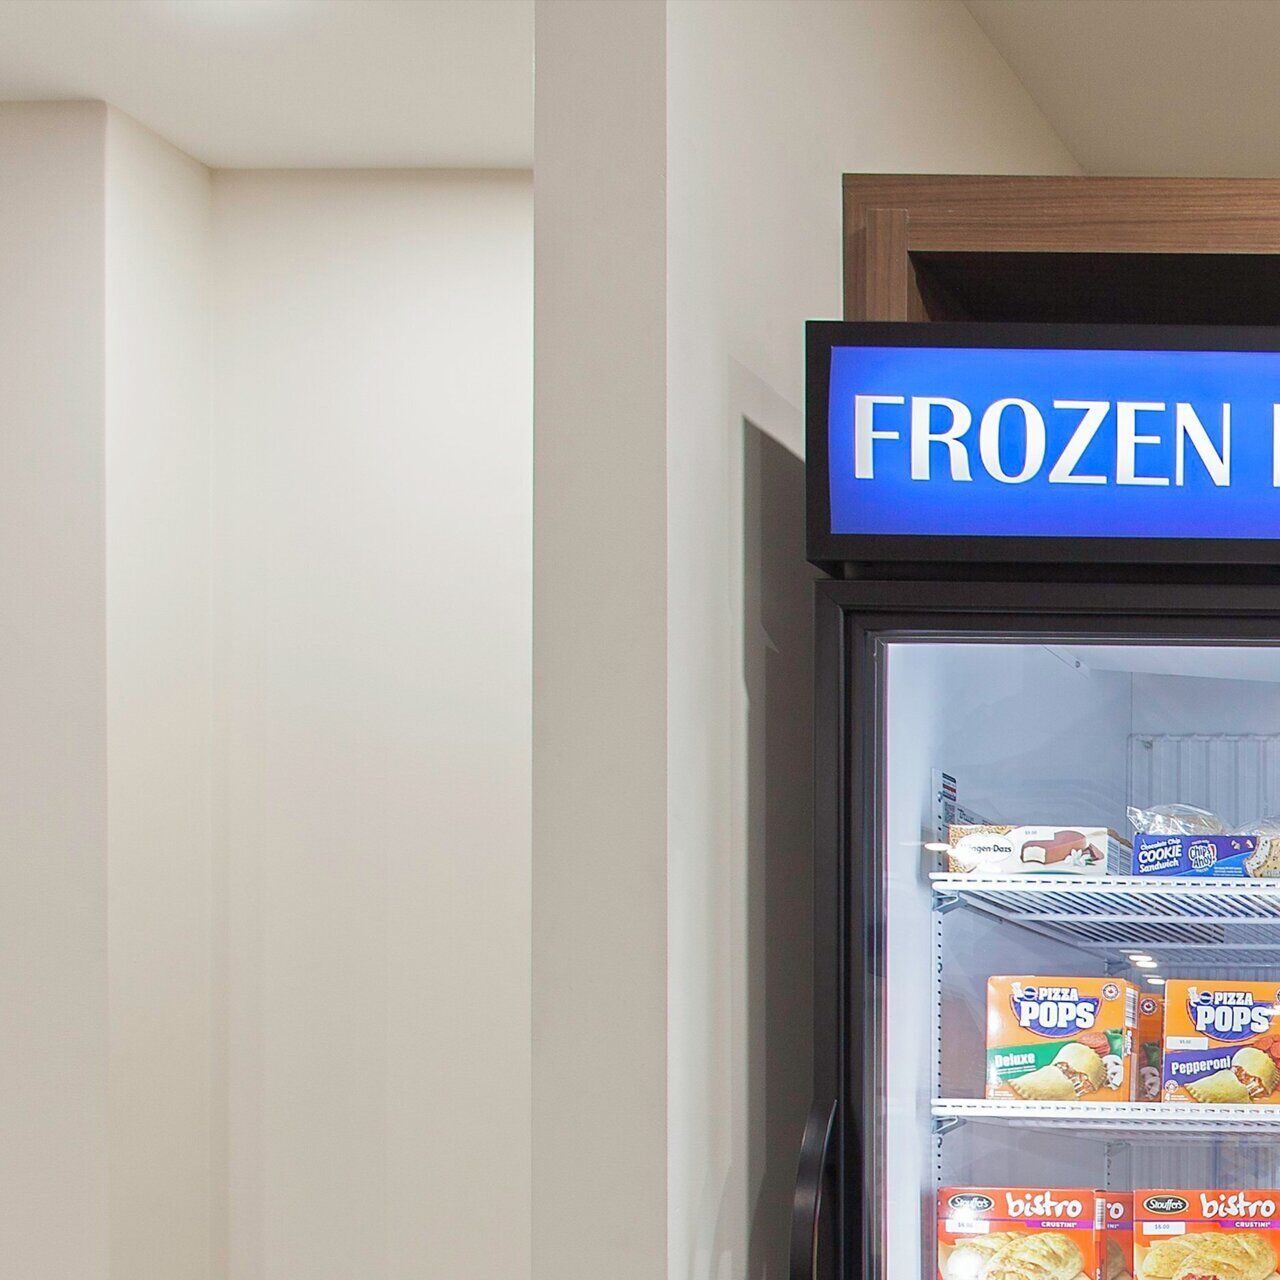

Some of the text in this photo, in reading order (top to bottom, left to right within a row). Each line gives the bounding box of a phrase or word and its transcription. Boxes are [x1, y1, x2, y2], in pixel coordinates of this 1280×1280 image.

[854, 394, 1231, 487] FROZEN
[1138, 845, 1183, 863] COOKIE
[1189, 845, 1212, 859] Chips
[1140, 860, 1180, 873] Sandwich
[1038, 987, 1079, 1001] PIZZA
[1214, 992, 1254, 1006] PIZZA
[1019, 1001, 1096, 1029] POPS
[1196, 1006, 1272, 1033] POPS
[994, 1052, 1036, 1068] Deluxe
[1171, 1055, 1231, 1075] Pepperoni
[1005, 1191, 1083, 1218] bistro
[1199, 1191, 1276, 1219] bistro
